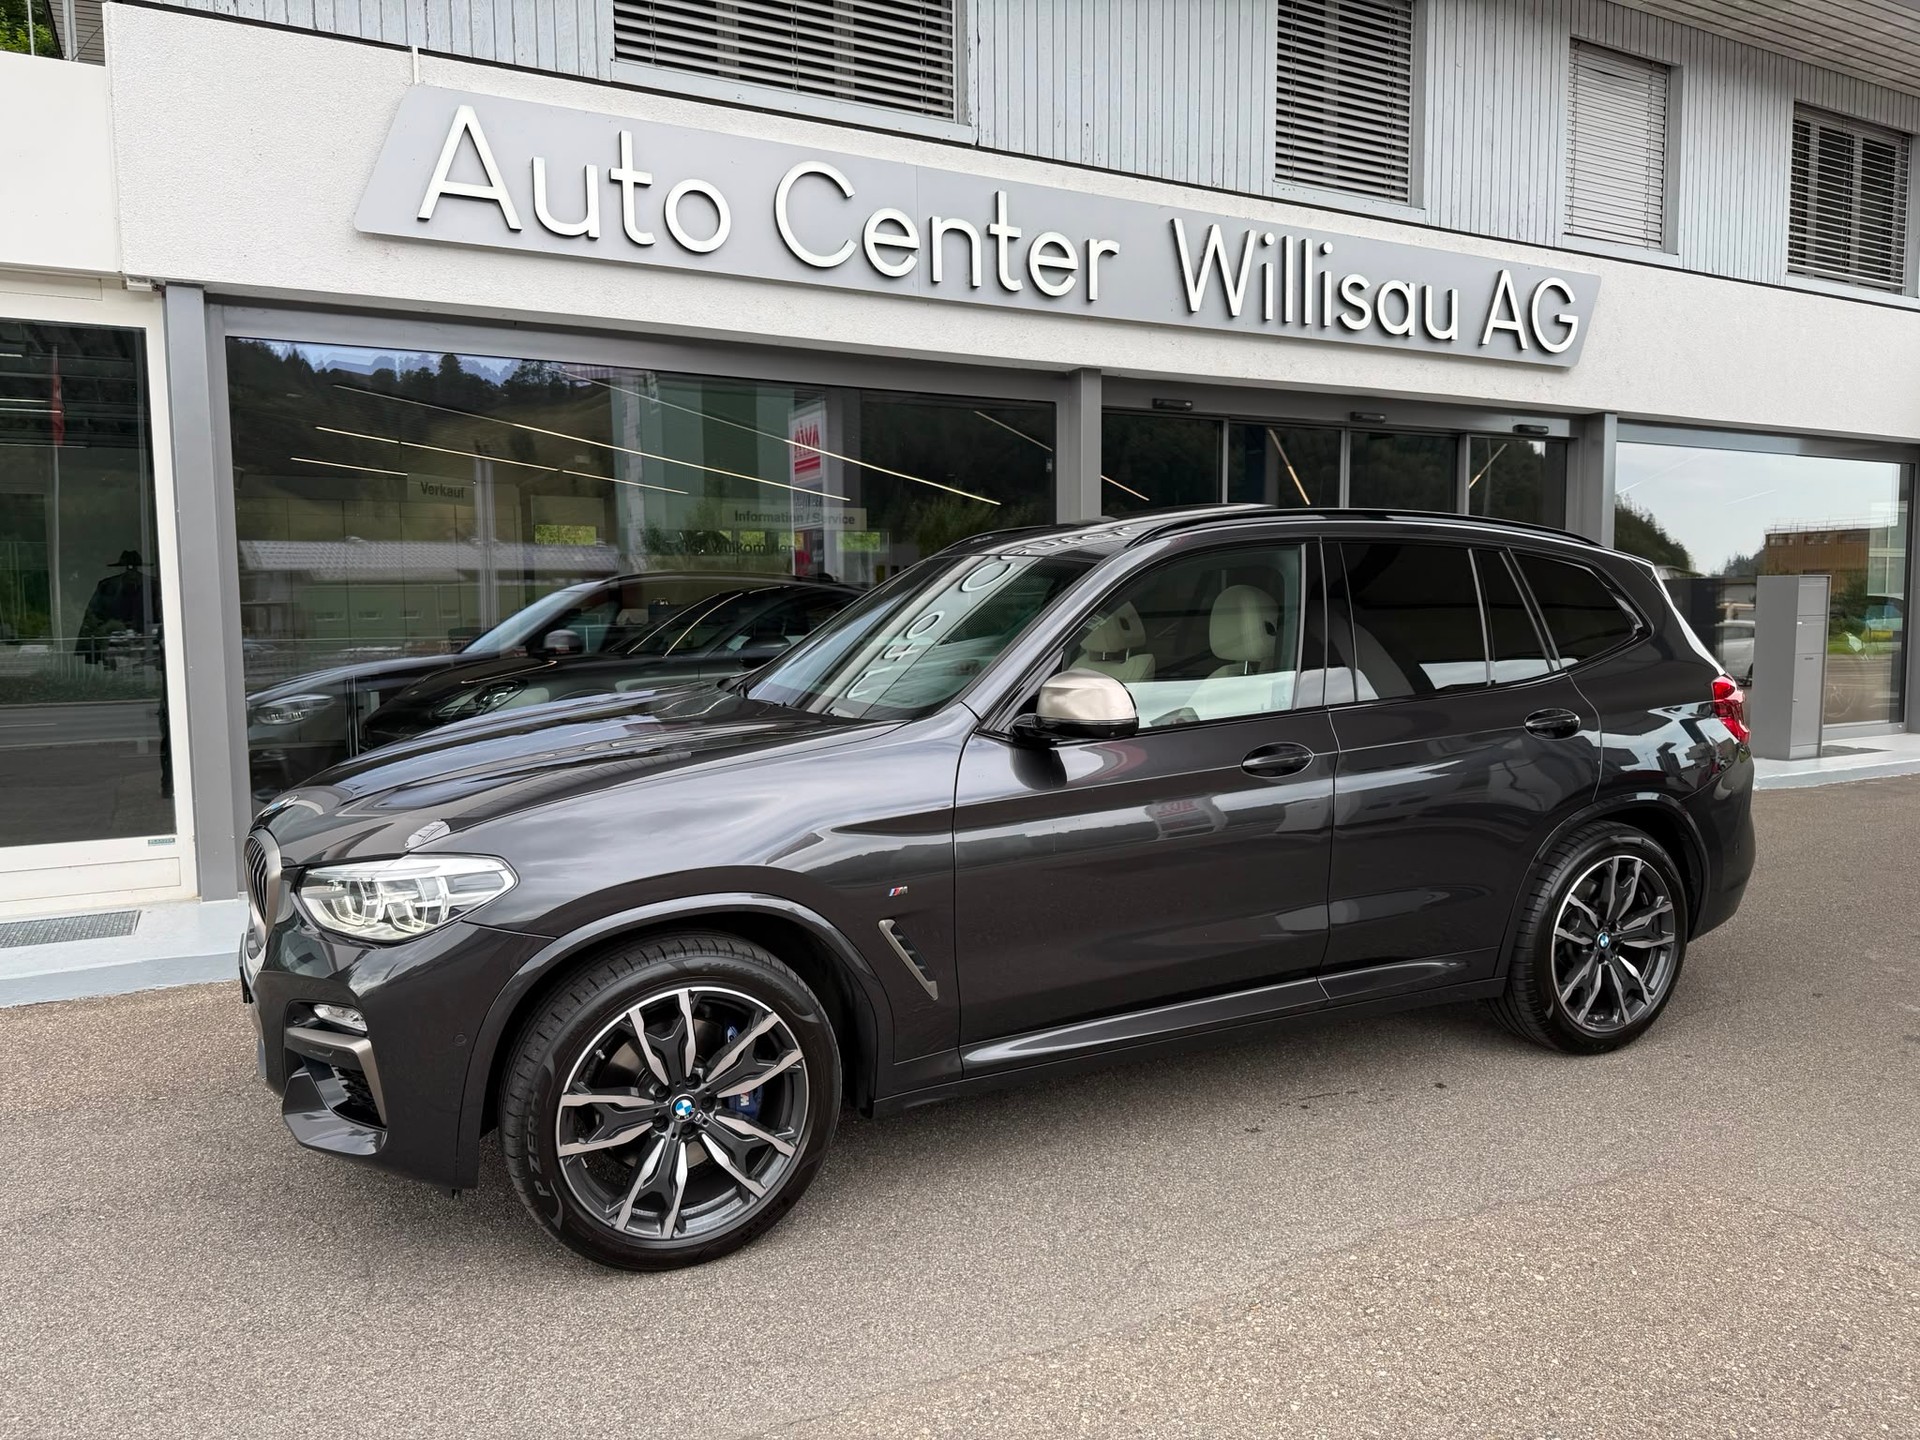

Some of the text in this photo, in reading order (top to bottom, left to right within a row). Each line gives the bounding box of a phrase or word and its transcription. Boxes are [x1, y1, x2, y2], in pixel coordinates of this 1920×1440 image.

[417, 105, 1580, 354] Auto Center Willisau AG
[420, 481, 465, 498] Verkauf
[734, 510, 804, 524] Information
[812, 513, 855, 525] Srvice
